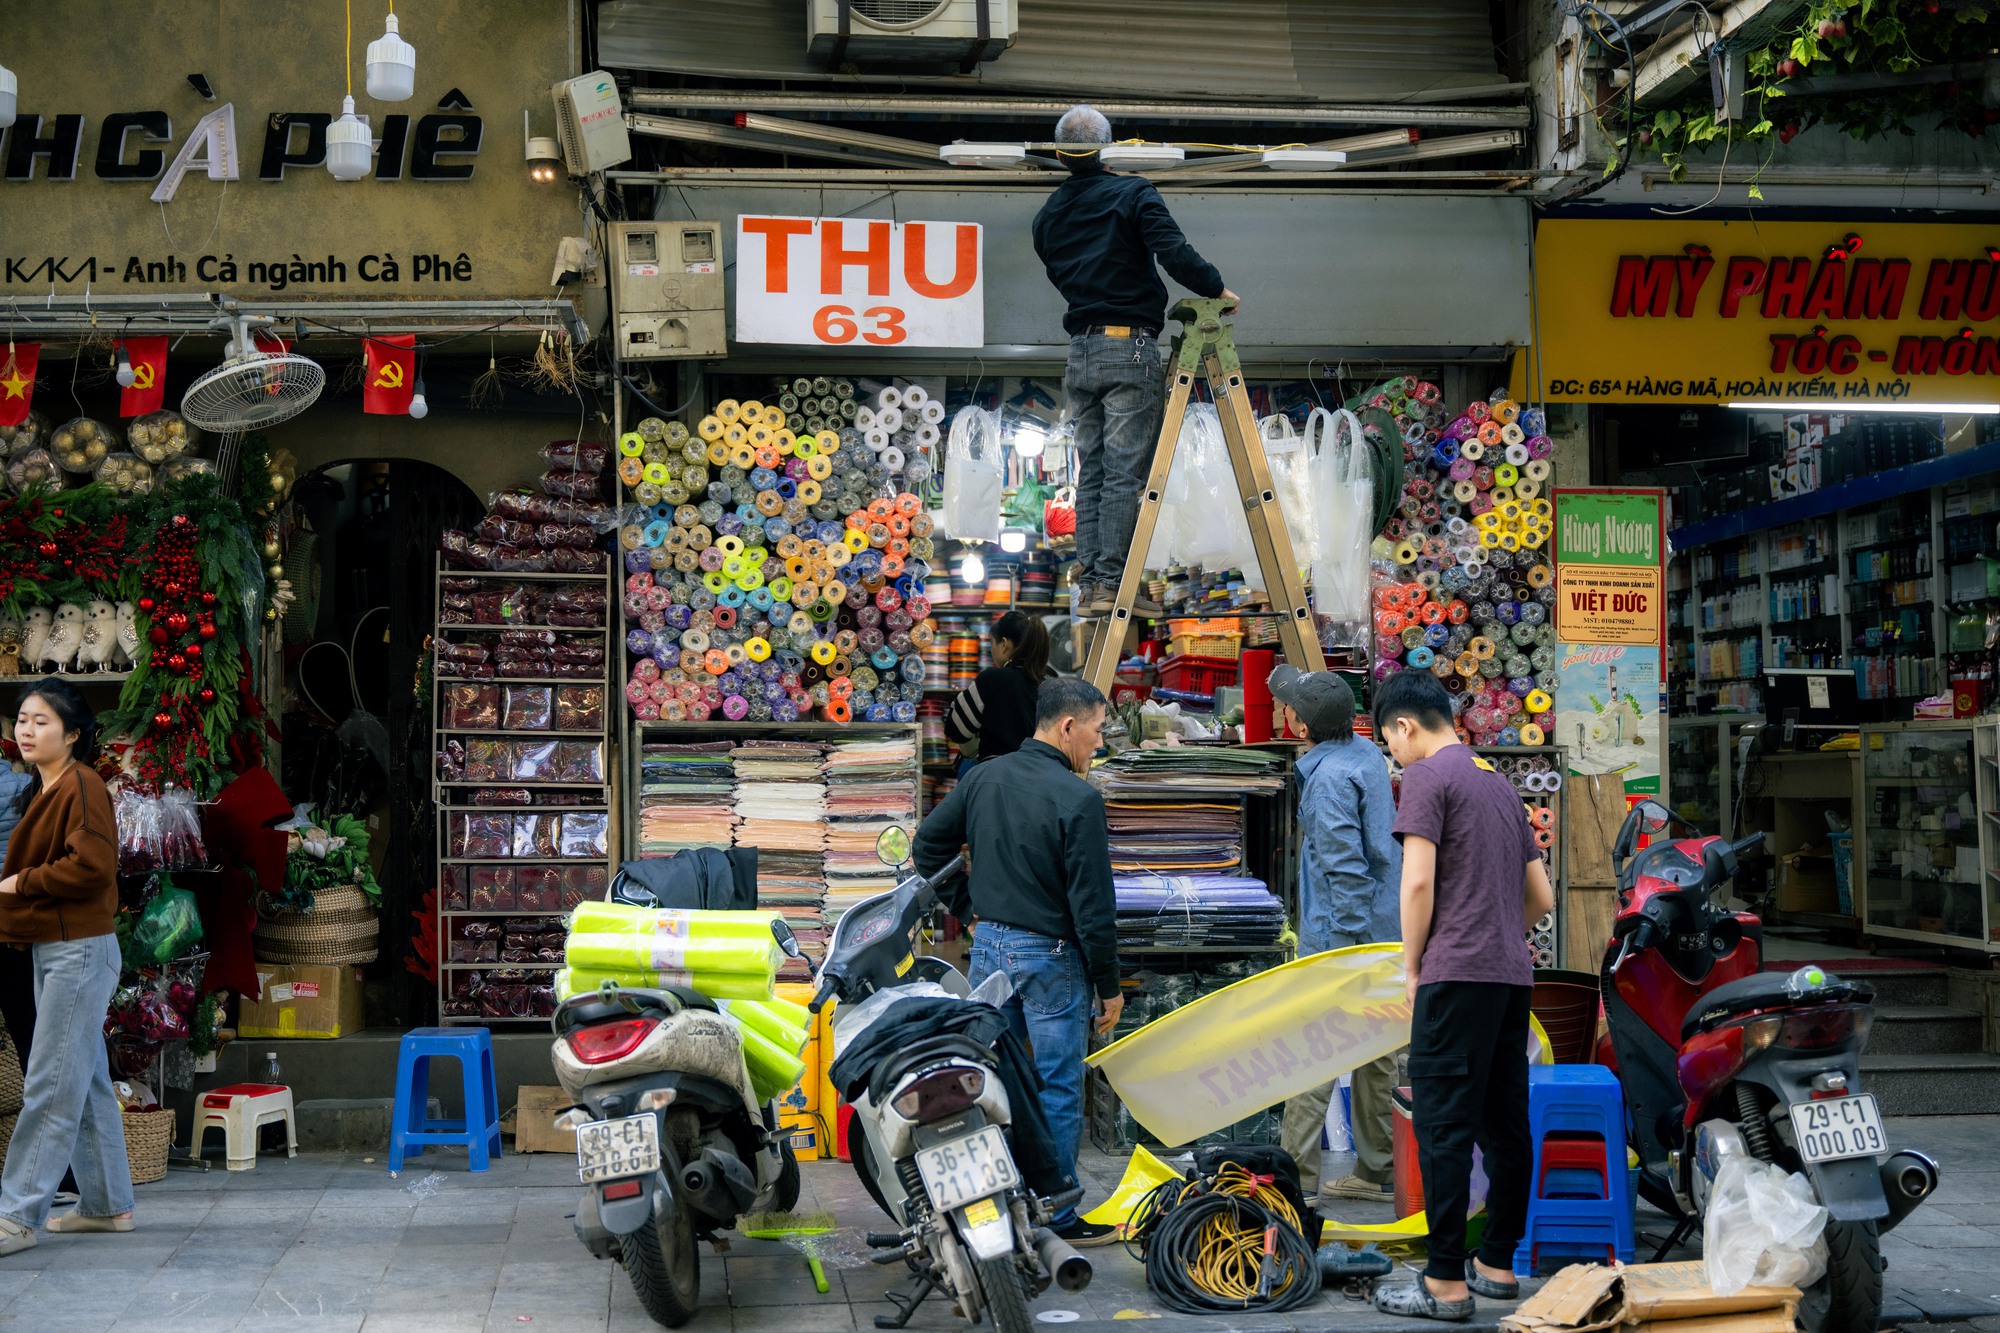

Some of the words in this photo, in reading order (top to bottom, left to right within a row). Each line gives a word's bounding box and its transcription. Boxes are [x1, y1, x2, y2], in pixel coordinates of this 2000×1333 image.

[123, 255, 186, 283] Anh
[196, 254, 237, 283] Cả
[248, 254, 347, 291] ngành
[358, 253, 399, 283] Cà
[413, 252, 472, 282] Phê
[743, 217, 978, 299] THU
[1609, 243, 1716, 318] MỸ
[1719, 232, 1912, 320] PHẨM
[812, 304, 907, 346] 63
[1769, 325, 1862, 375] TÓC
[1550, 379, 1584, 395] ĐC:
[1625, 376, 1683, 396] HÀNG
[1687, 377, 1722, 399] MÃ,
[1725, 376, 1782, 397] HOÀN
[1786, 376, 1838, 399] KIẾM,
[1843, 377, 1871, 397] HÀ
[1875, 378, 1911, 401] NỘI
[1563, 513, 1600, 559] Hùng
[1605, 515, 1653, 560] Nương
[1571, 589, 1608, 615] VIỆT
[1612, 590, 1647, 613] ĐỨC
[1589, 644, 1625, 666] life
[937, 1120, 965, 1133] HONDA
[1804, 1099, 1866, 1130] 29-C1
[1805, 1126, 1880, 1158] 000.09
